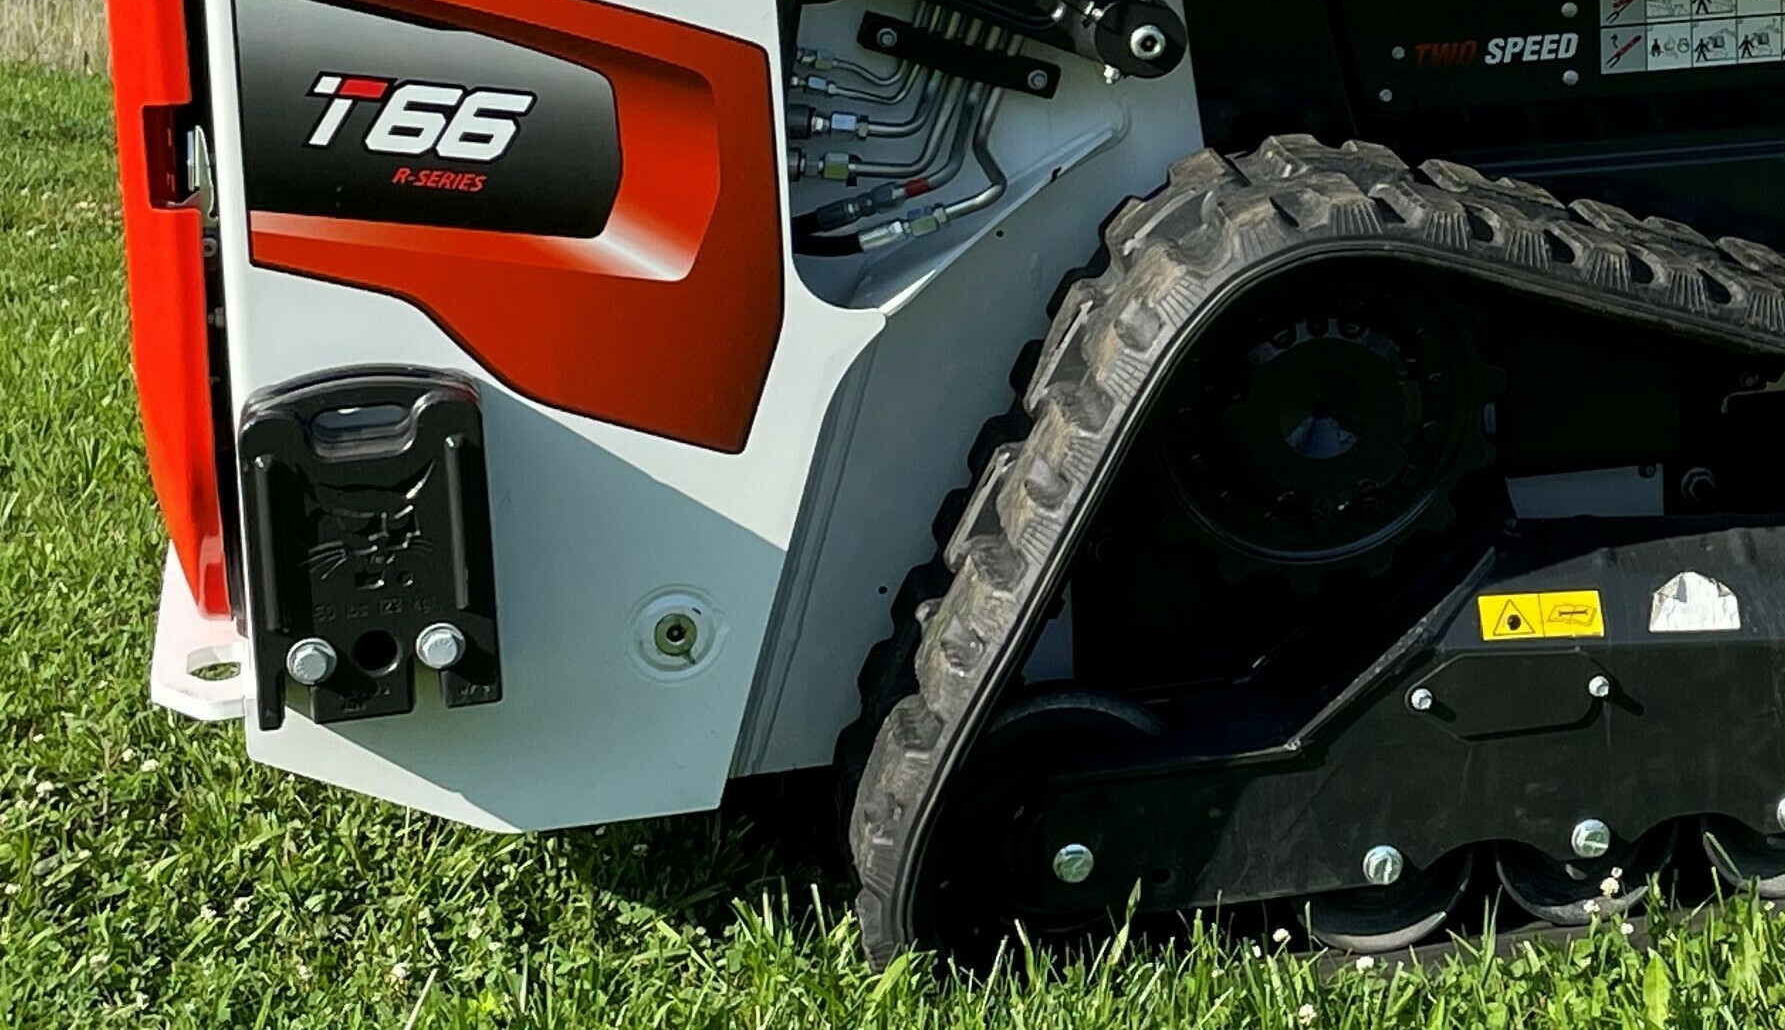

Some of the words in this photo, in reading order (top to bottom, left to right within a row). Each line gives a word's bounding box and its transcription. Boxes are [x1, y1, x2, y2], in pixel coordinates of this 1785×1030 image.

[1414, 39, 1478, 66] TWO
[1484, 32, 1579, 65] SPEED
[306, 73, 536, 161] T66
[392, 167, 488, 192] R-SERIES
